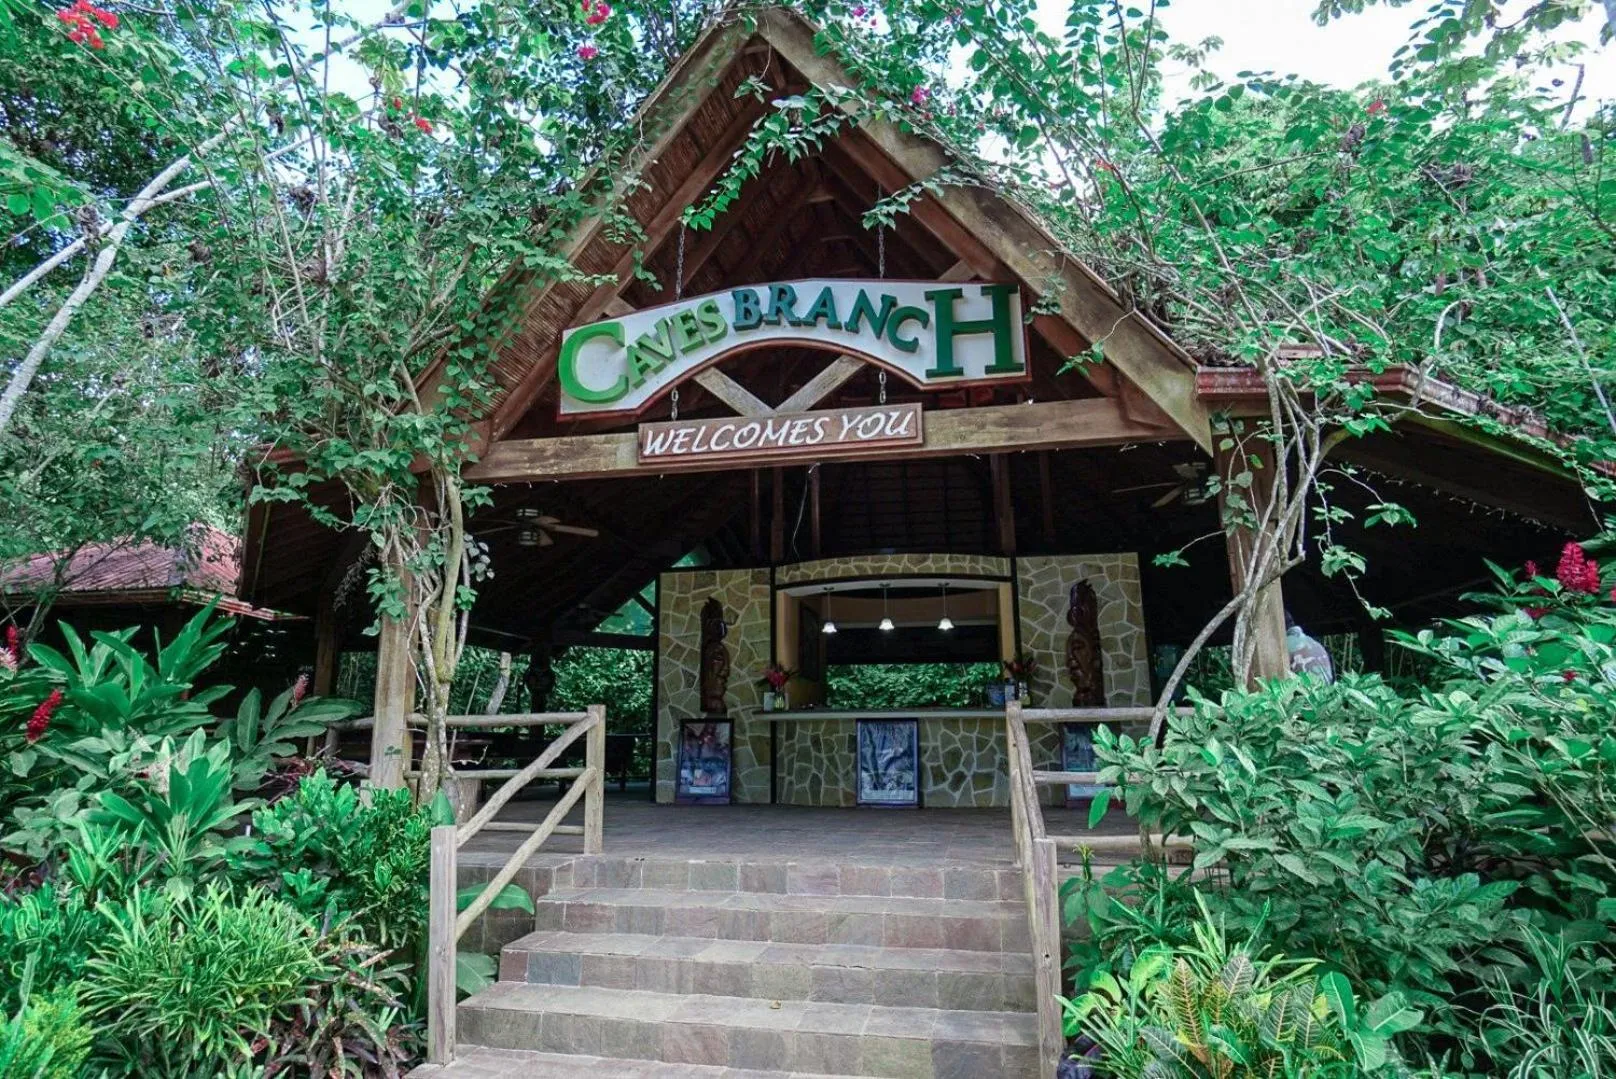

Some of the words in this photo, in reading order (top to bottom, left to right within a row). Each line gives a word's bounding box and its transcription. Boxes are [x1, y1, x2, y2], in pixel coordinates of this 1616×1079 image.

[559, 298, 728, 404] CAVES
[733, 284, 1024, 378] BRANCH
[643, 417, 829, 456] WELCOMES
[838, 411, 914, 440] YOU
